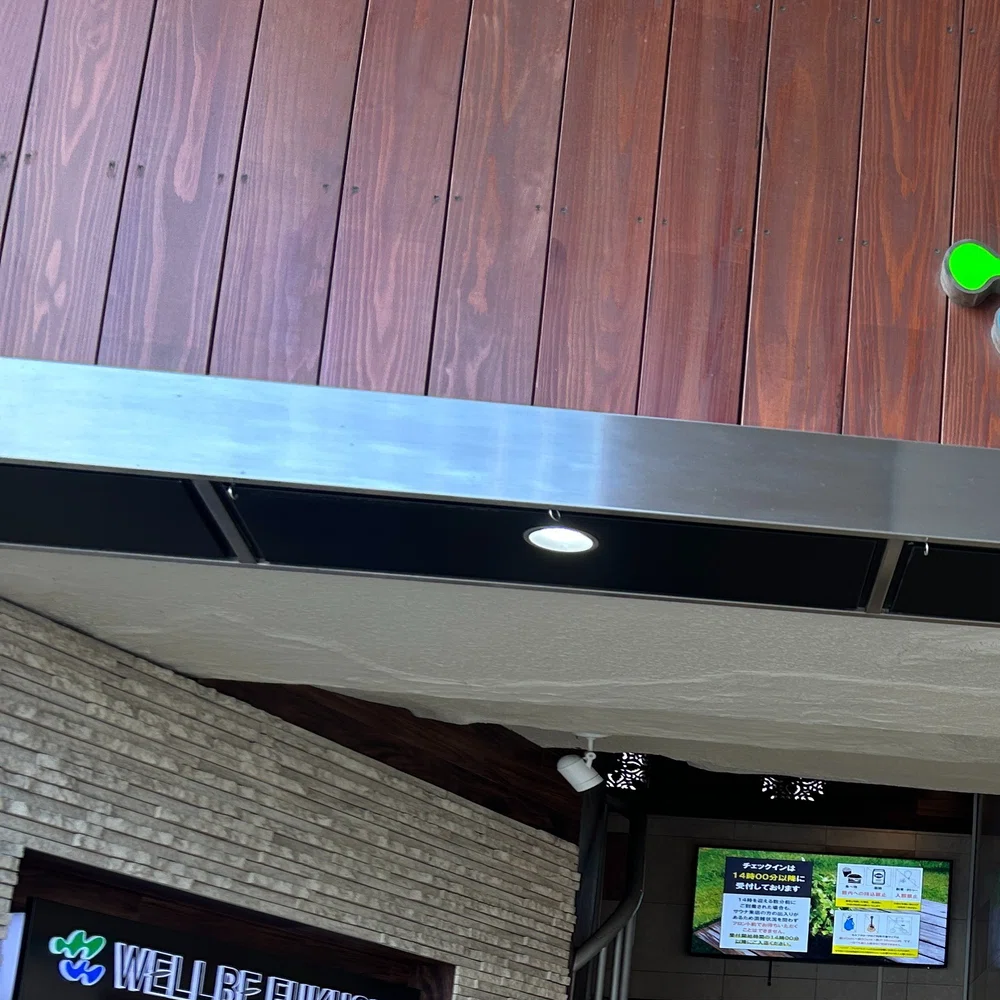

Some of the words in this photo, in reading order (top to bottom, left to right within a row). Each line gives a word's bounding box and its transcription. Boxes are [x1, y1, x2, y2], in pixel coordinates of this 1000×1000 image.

[743, 862, 796, 872] チェックインは
[732, 871, 806, 883] 14時00分以降に
[735, 882, 801, 893] 受付しております
